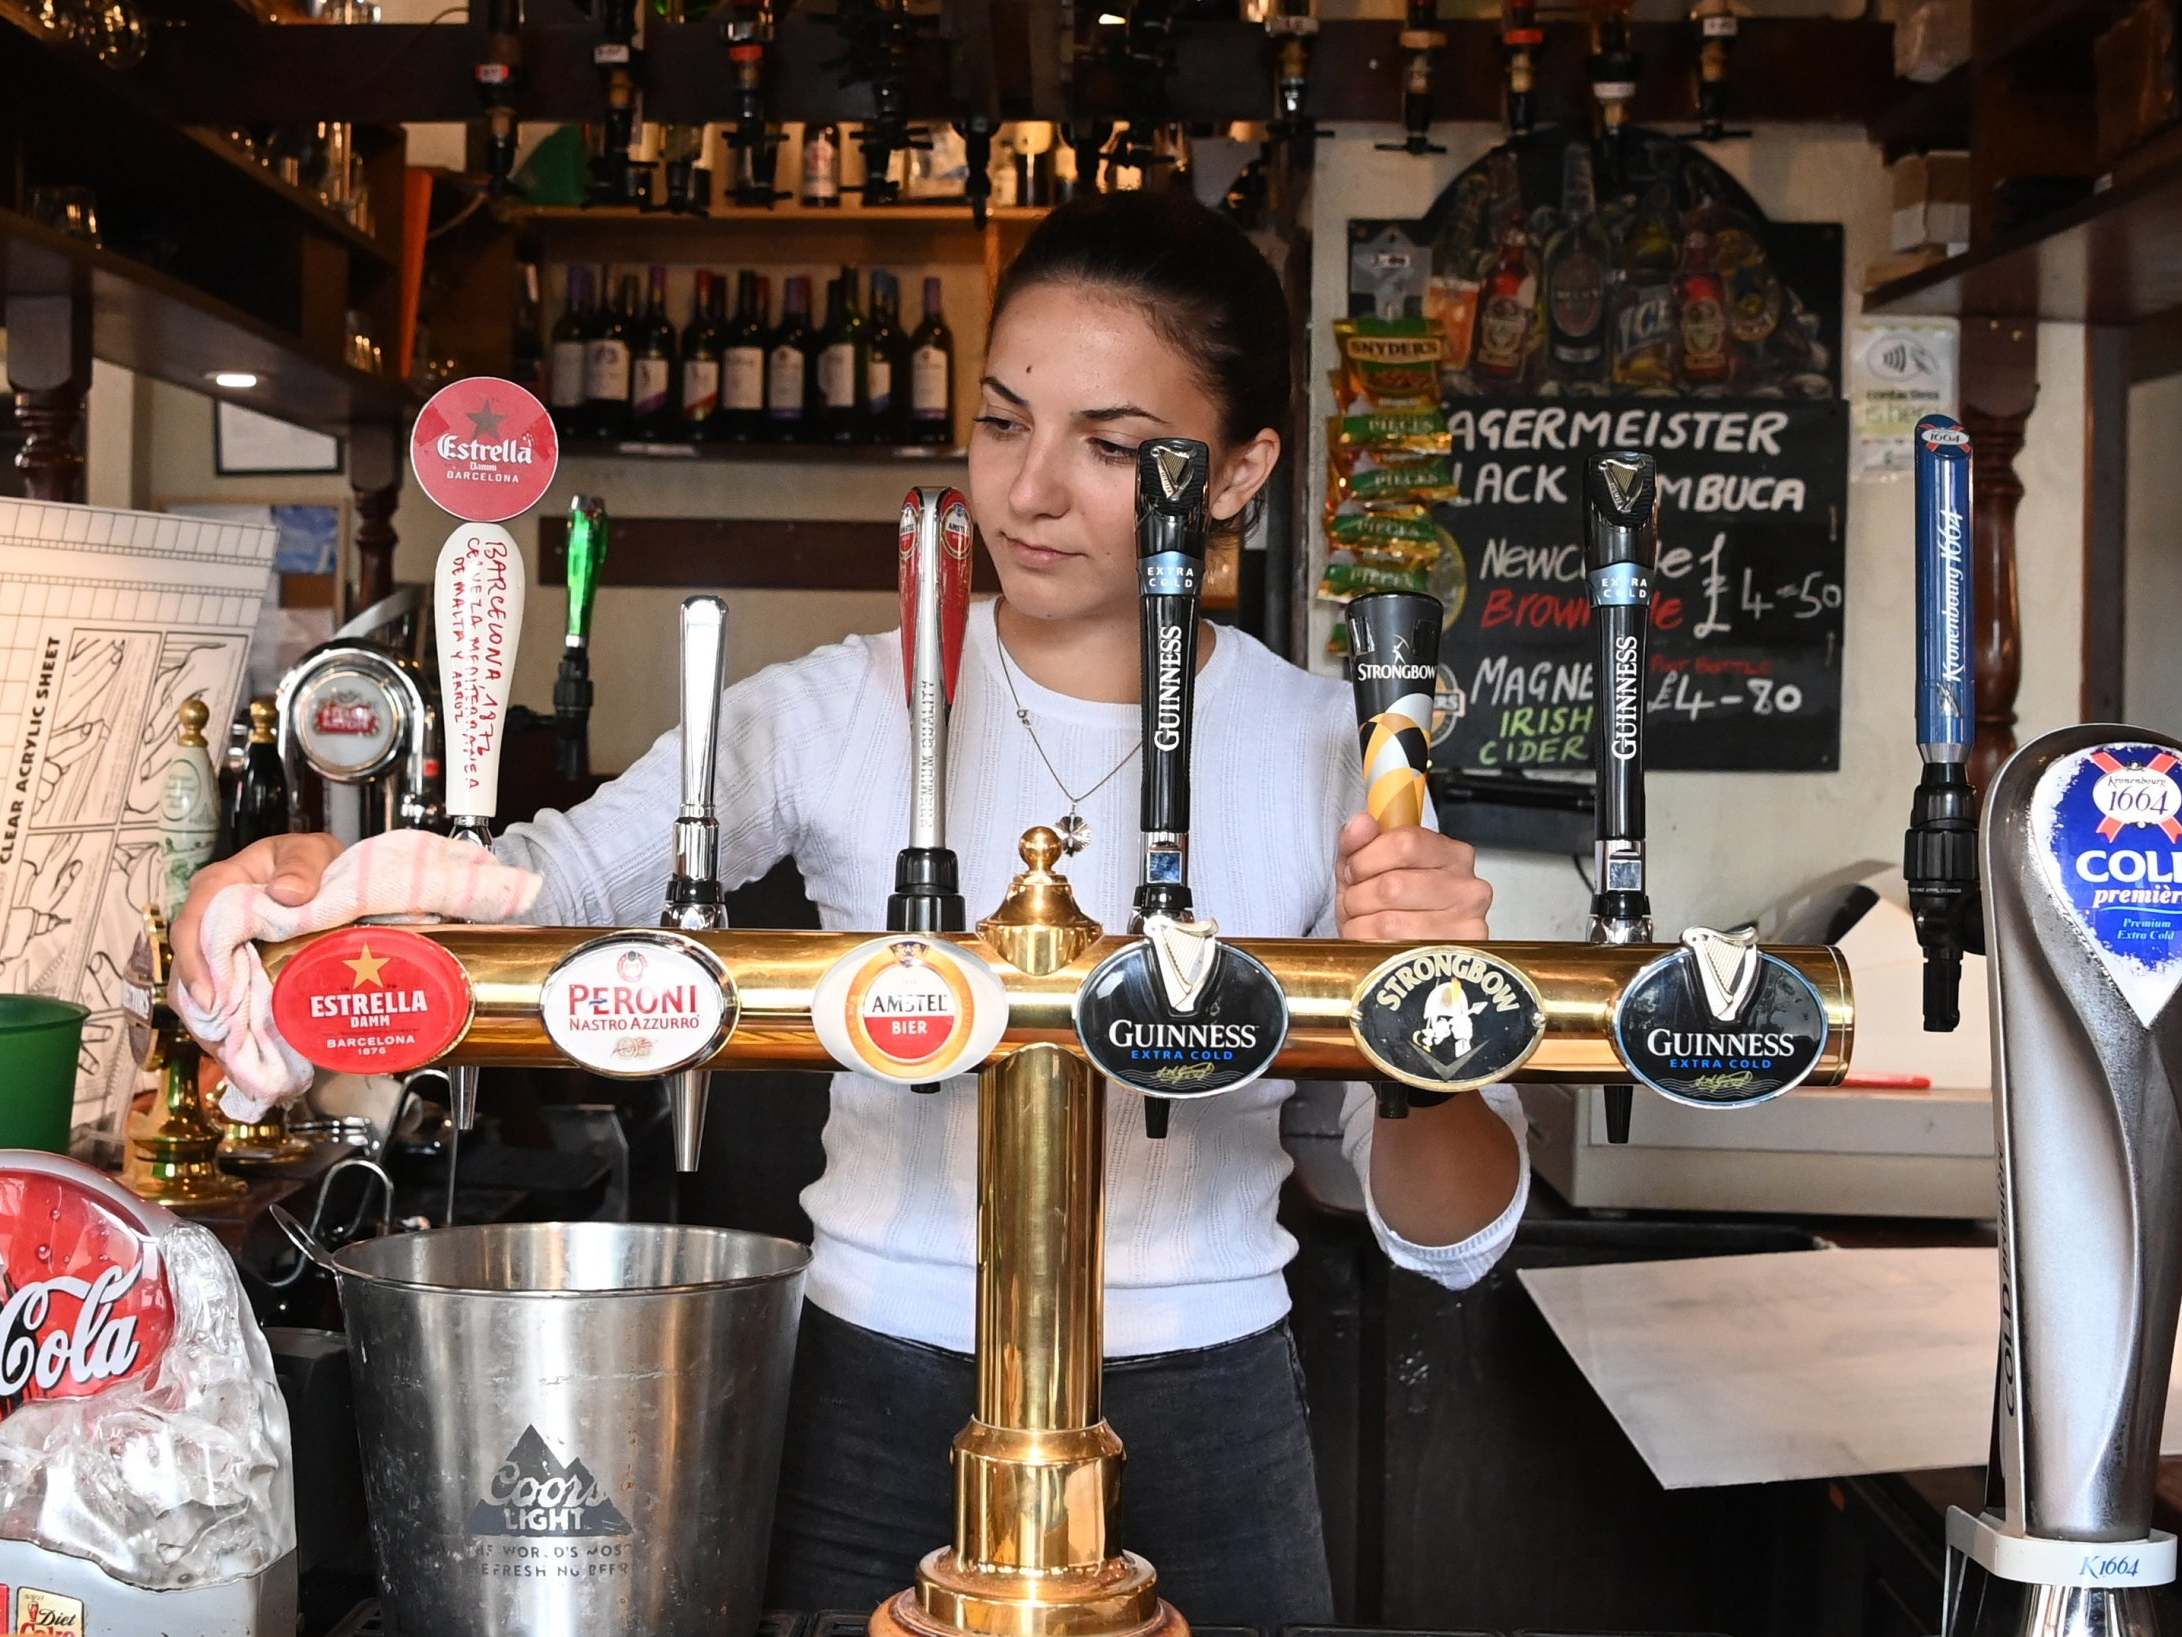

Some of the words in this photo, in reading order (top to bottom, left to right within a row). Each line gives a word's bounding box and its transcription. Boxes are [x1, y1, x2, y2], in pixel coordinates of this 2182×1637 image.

[1447, 406, 1788, 456] AGERMEISTER
[437, 432, 533, 465] Estrella
[447, 470, 519, 484] BARCELONA
[1453, 462, 1568, 507] LACK
[1656, 474, 1806, 513] MBUCA
[1939, 509, 1963, 562] 1664
[466, 537, 483, 630] CEVEZA
[1148, 577, 1193, 589] COLD
[1601, 577, 1648, 588] EXRA
[1942, 568, 1965, 682] Kronenbourg
[1357, 663, 1437, 681] STRONGBOW
[1470, 656, 1594, 706] MAGNE
[1154, 625, 1182, 752] GUINNESS
[1611, 635, 1637, 760] GUINNESS
[921, 680, 935, 749] QUALITY
[1500, 706, 1594, 739] IRISH
[0, 800, 25, 865] CLEAR
[16, 706, 46, 793] ACRYLIC
[36, 636, 60, 699] SHEET
[1479, 738, 1588, 766] CIDER
[2108, 785, 2169, 816] 1664
[2092, 884, 2182, 910] premièr
[2117, 930, 2148, 941] Extra
[2150, 930, 2175, 941] Cold
[2122, 917, 2172, 929] Premium
[1376, 953, 1521, 1012] STRONGBOW
[310, 990, 429, 1018] ESTRELLA
[568, 984, 699, 1016] PERONI
[871, 994, 948, 1013] AMSTEL
[351, 1014, 390, 1029] DAMM
[569, 1017, 628, 1031] NASTRO
[630, 1016, 700, 1031] AZZURRO
[891, 1020, 929, 1036] BIER
[1108, 1019, 1257, 1049] GUINNESS
[326, 1034, 416, 1049] BARCELONA
[357, 1046, 388, 1057] 1876
[1131, 1050, 1185, 1061] EXTRA
[1190, 1050, 1234, 1061] COLD
[1647, 1028, 1796, 1058] GUINNESS
[1669, 1058, 1722, 1070] EXTRA
[1729, 1058, 1774, 1070] COLD
[2002, 1282, 2015, 1417] COLD
[490, 1461, 608, 1508] Coors
[504, 1507, 585, 1531] LIGHT
[503, 1545, 579, 1559] WORD'S
[481, 1563, 580, 1578] EFRESHNG
[2080, 1555, 2140, 1580] K1664
[36, 1608, 77, 1627] Diet
